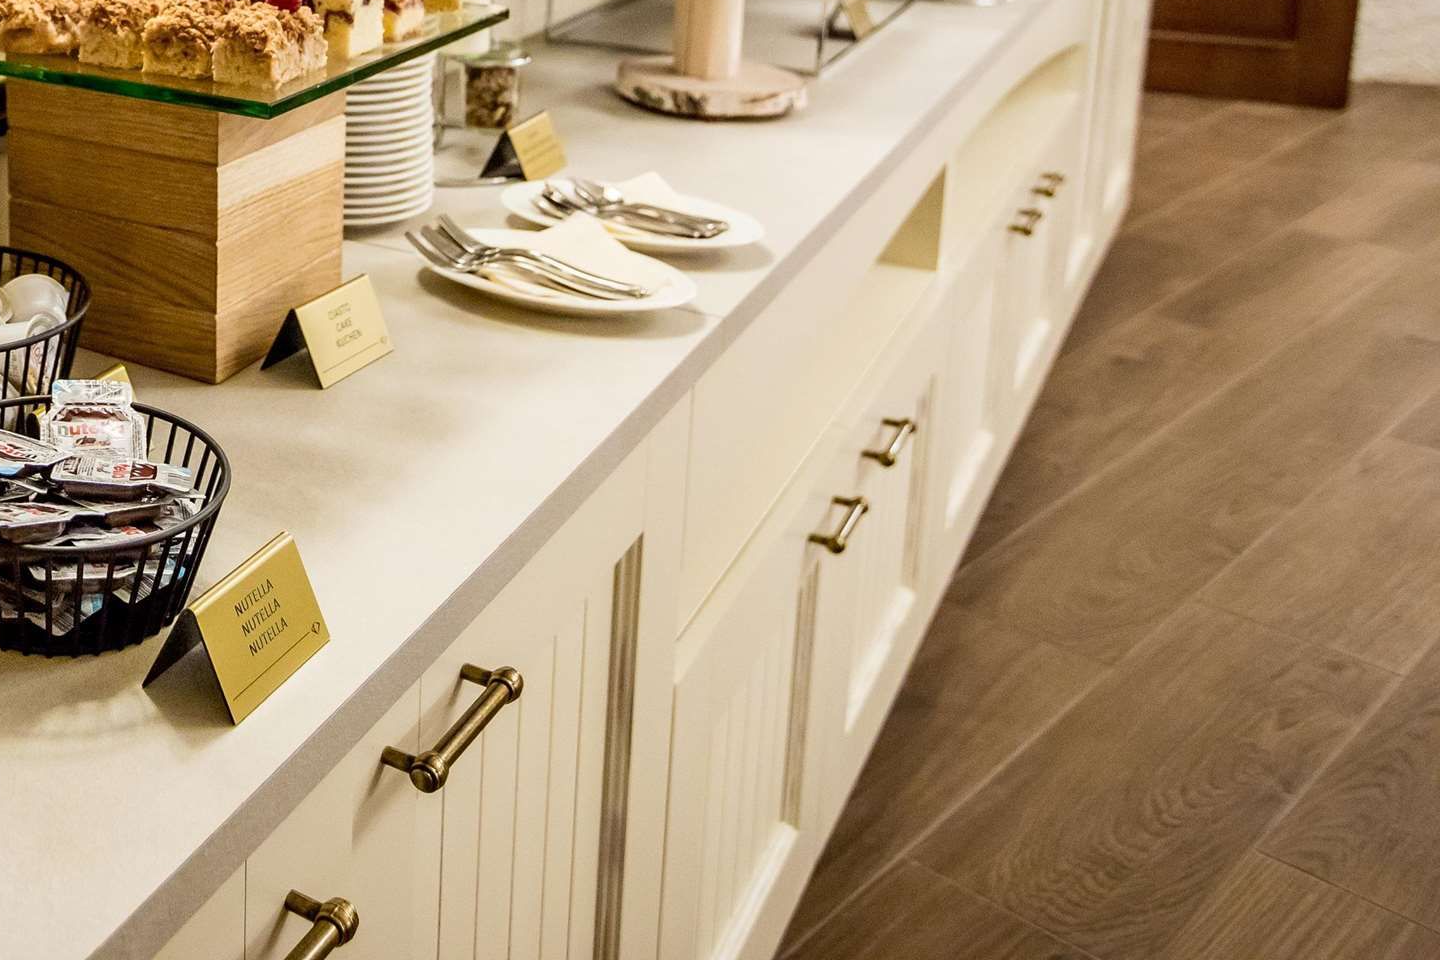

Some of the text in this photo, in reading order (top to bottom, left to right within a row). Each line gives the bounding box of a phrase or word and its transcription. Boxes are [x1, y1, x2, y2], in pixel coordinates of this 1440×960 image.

[57, 420, 126, 436] nutea
[234, 578, 274, 617] NUTELLA
[241, 598, 281, 638] NUTELLA
[248, 617, 289, 657] NUTELLA
